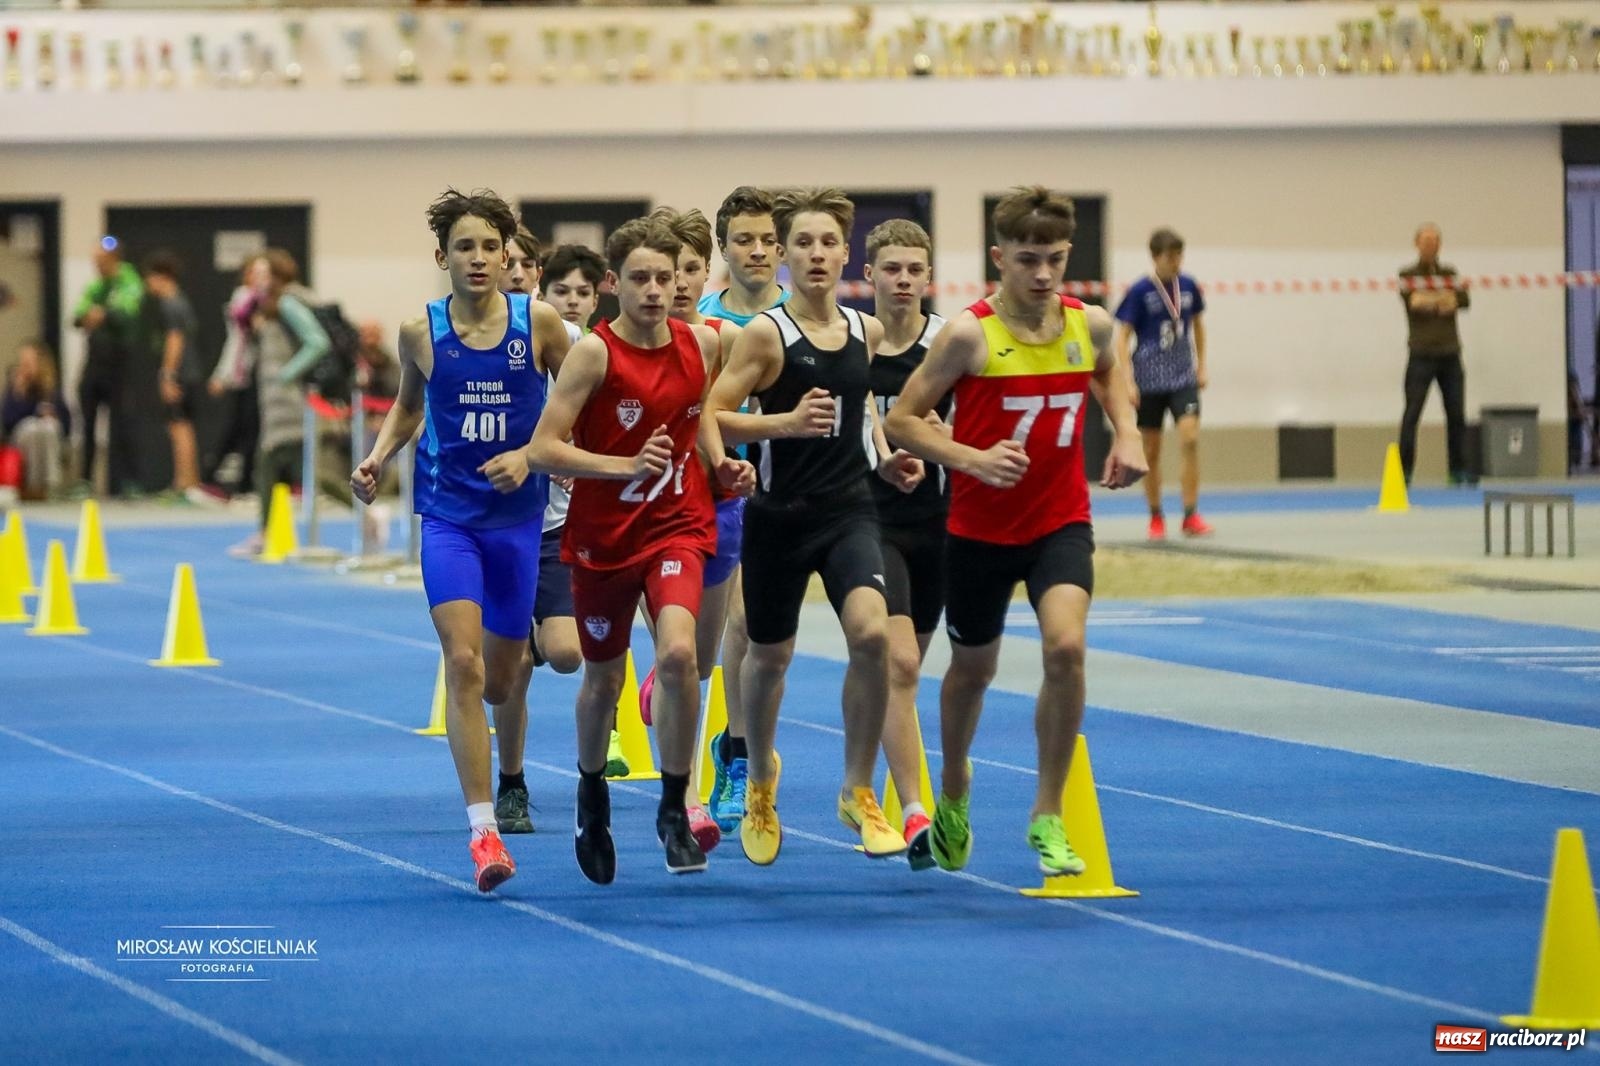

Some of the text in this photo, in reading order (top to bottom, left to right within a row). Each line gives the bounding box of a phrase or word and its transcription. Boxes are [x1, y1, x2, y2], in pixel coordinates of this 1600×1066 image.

[467, 380, 503, 391] TL POGOŃ
[459, 393, 511, 405] RUDA ŚLĄSKA
[461, 412, 506, 442] 401
[1002, 391, 1084, 448] 77
